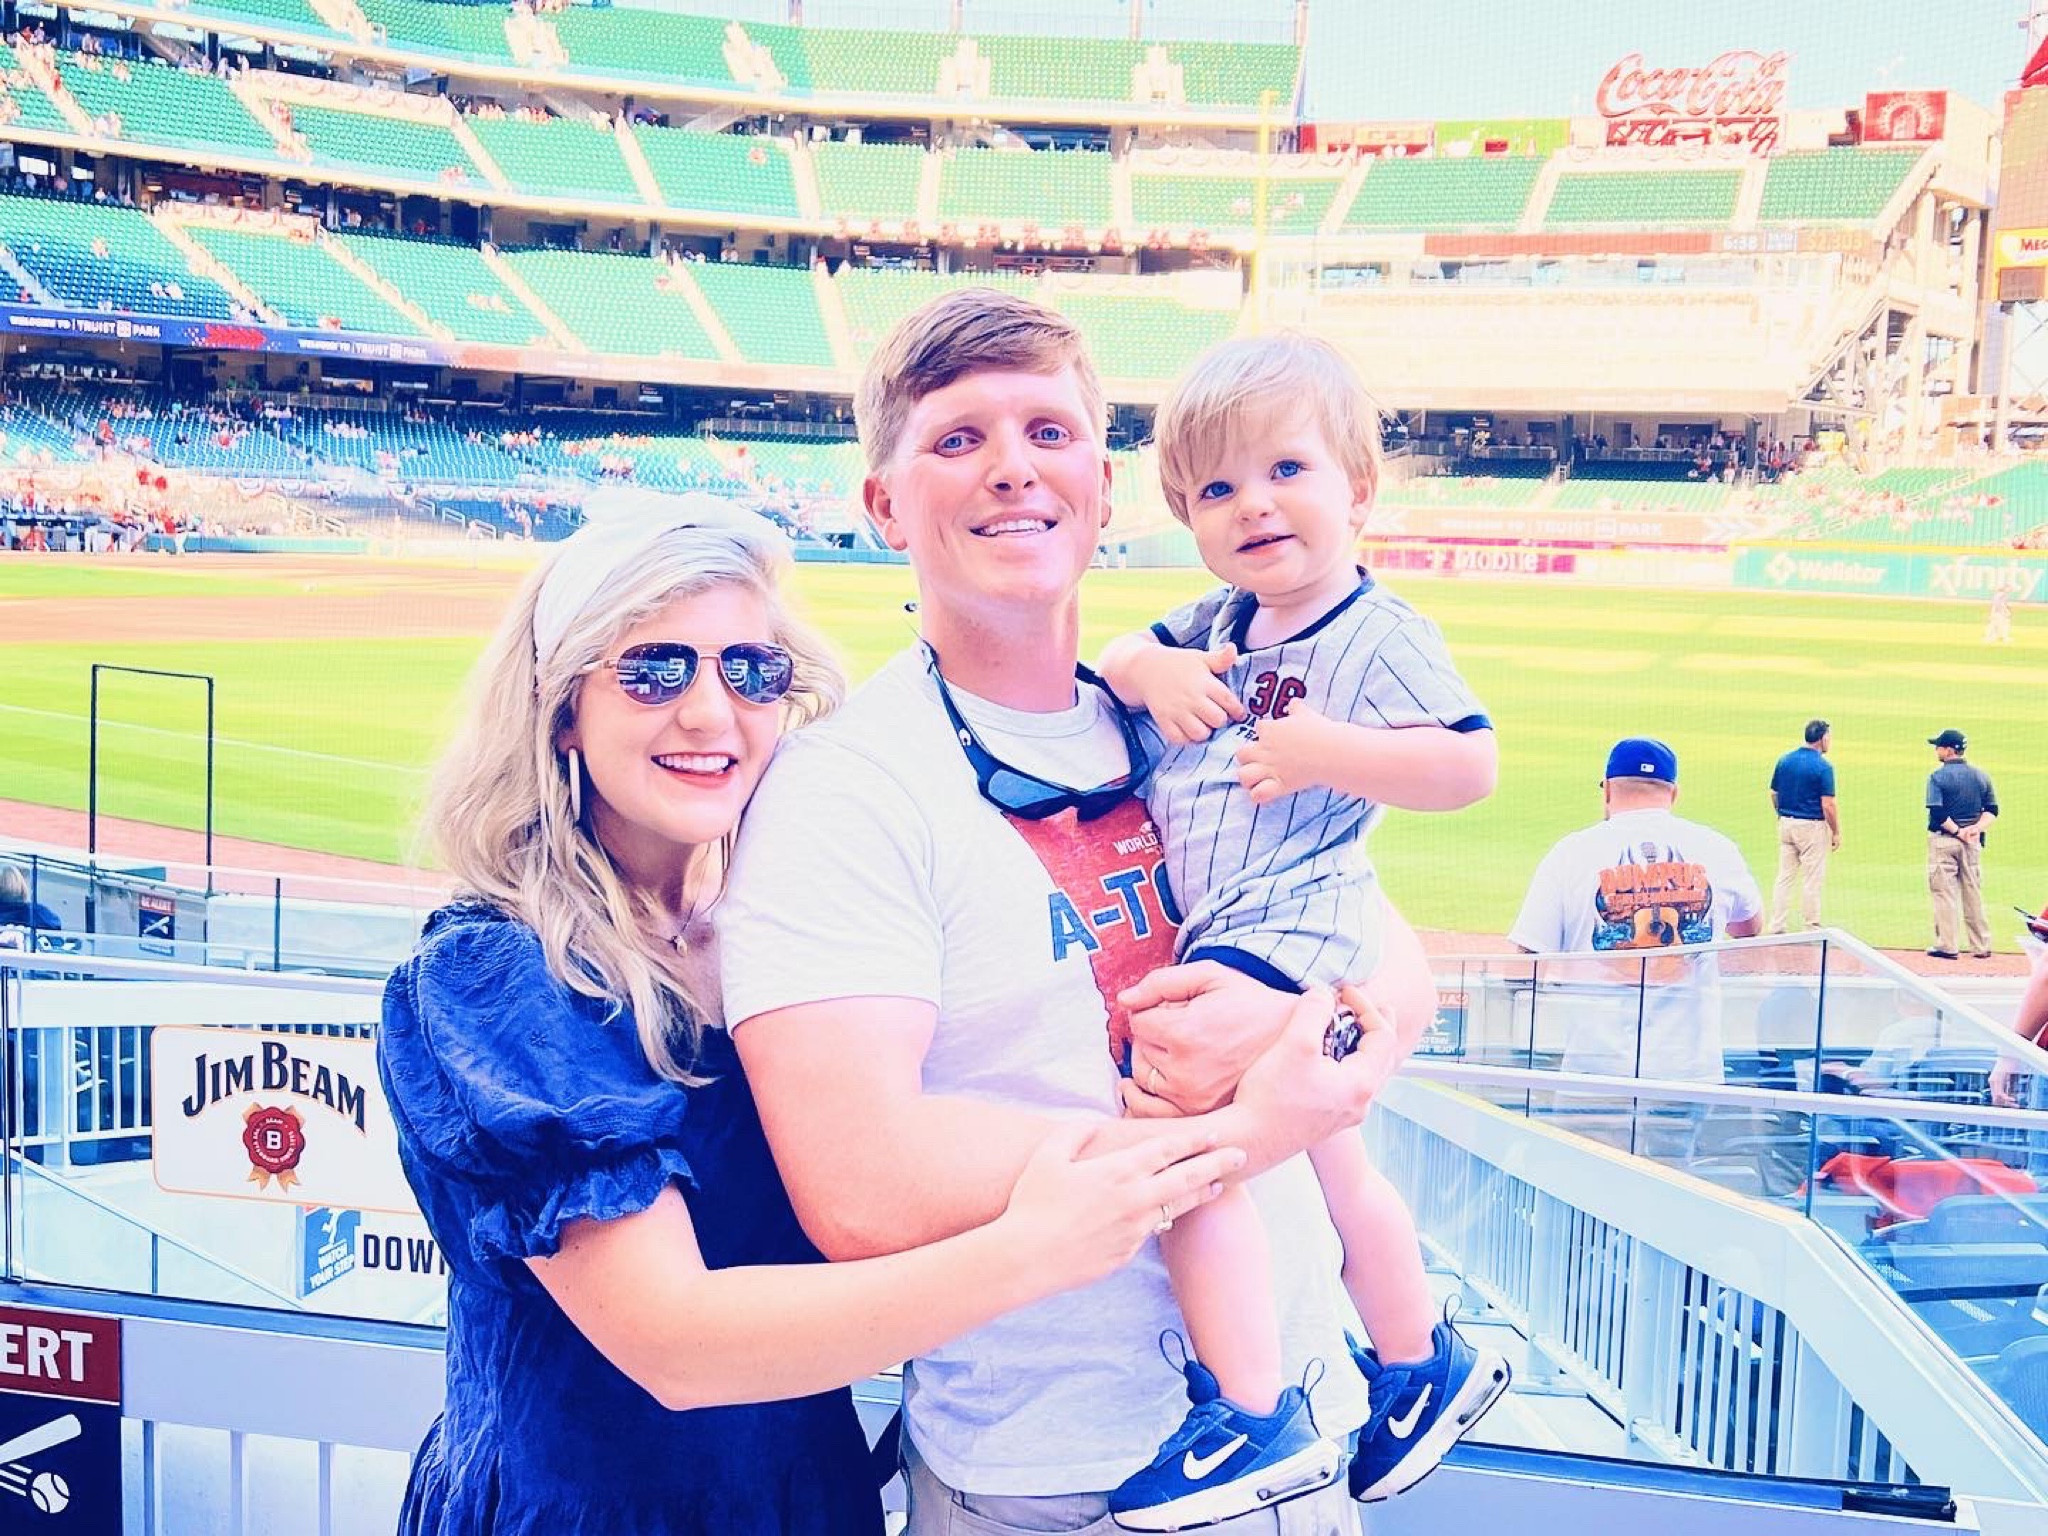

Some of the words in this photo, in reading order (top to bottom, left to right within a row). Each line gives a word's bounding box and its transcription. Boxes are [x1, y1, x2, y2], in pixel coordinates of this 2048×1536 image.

[1596, 50, 1788, 118] Coca-Cola
[1616, 522, 1663, 537] PARK
[1929, 555, 2044, 601] xfinity
[1248, 670, 1307, 720] 36
[1112, 832, 1160, 857] WORLD
[182, 1053, 254, 1117] JIM
[261, 1041, 366, 1133] BEAM
[266, 1130, 281, 1150] B
[310, 1262, 334, 1289] YOUR
[333, 1253, 355, 1276] STEP
[318, 1242, 348, 1269] WATCH
[364, 1233, 446, 1275] DOW
